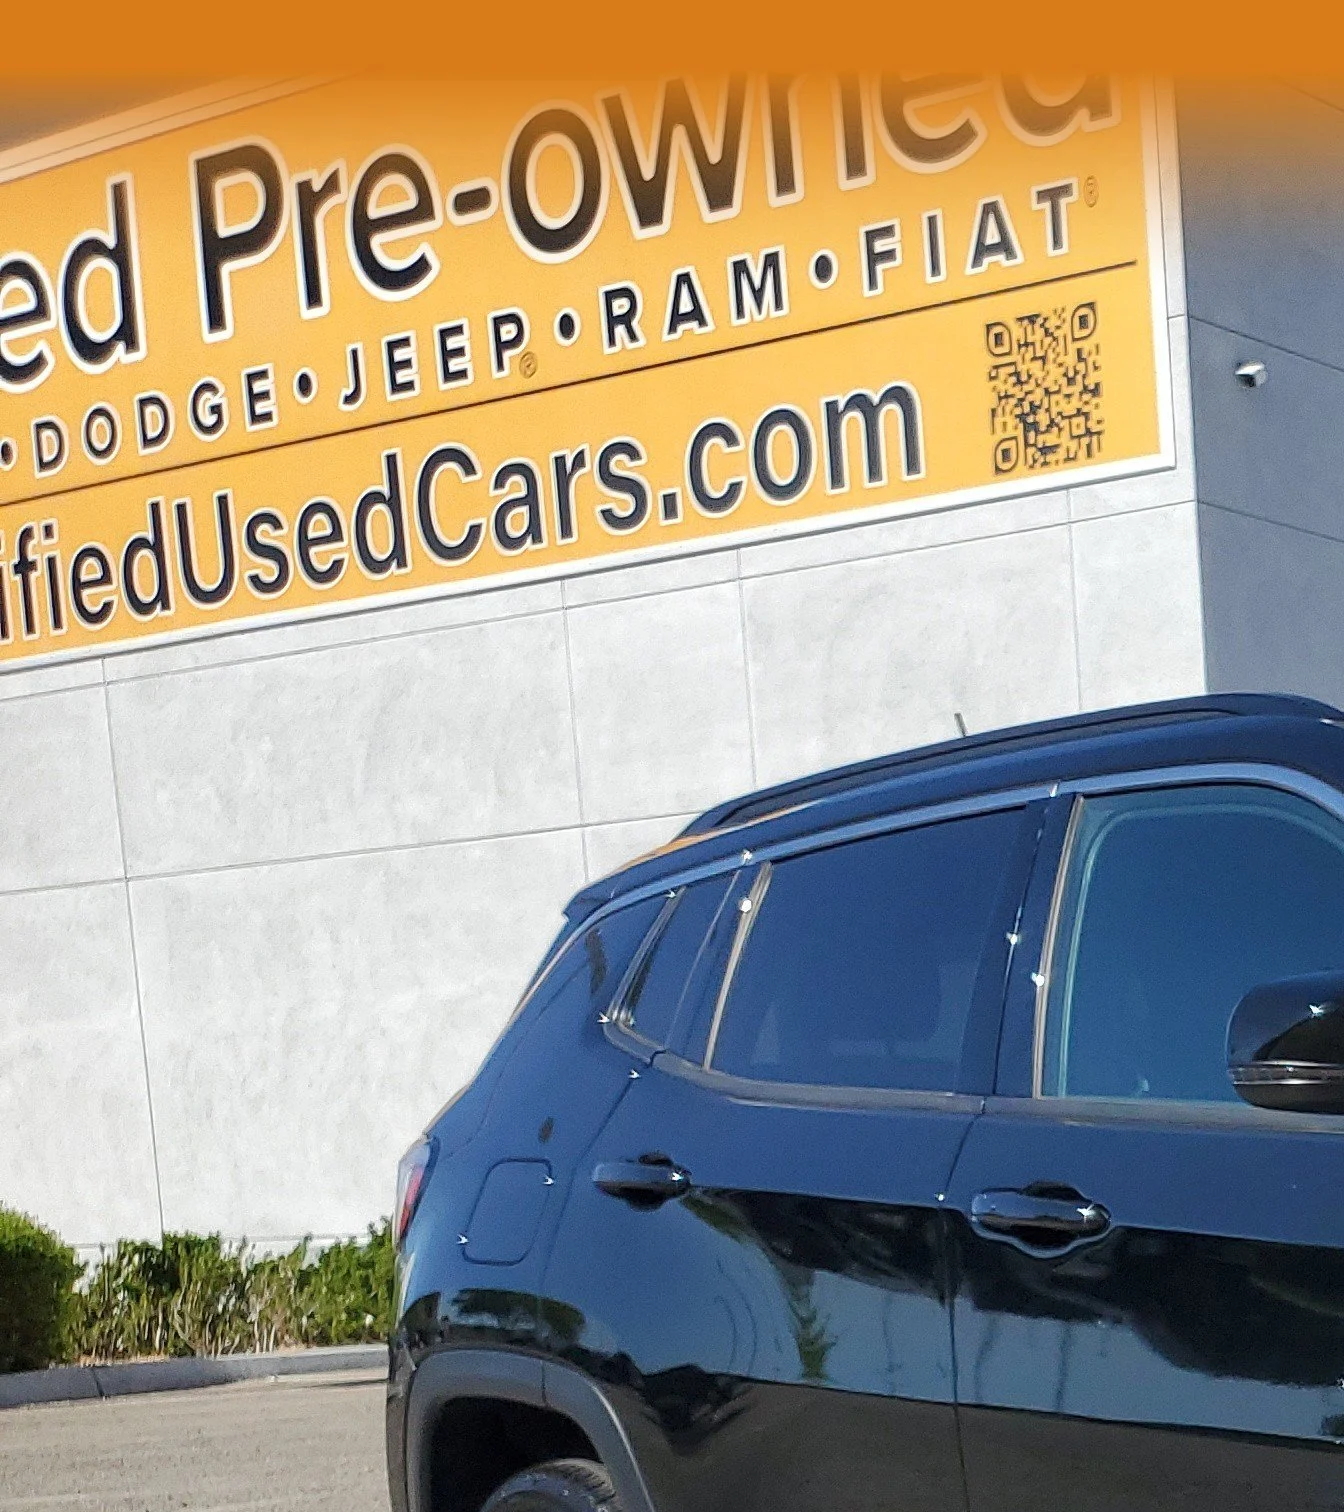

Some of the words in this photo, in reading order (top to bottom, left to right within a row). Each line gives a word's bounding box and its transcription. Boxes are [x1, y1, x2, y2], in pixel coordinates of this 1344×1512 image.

[0, 180, 142, 385] ed
[33, 366, 276, 476] DODGE
[340, 310, 526, 408] JEEP
[600, 248, 786, 350] RAM
[860, 180, 1076, 295] FIAT
